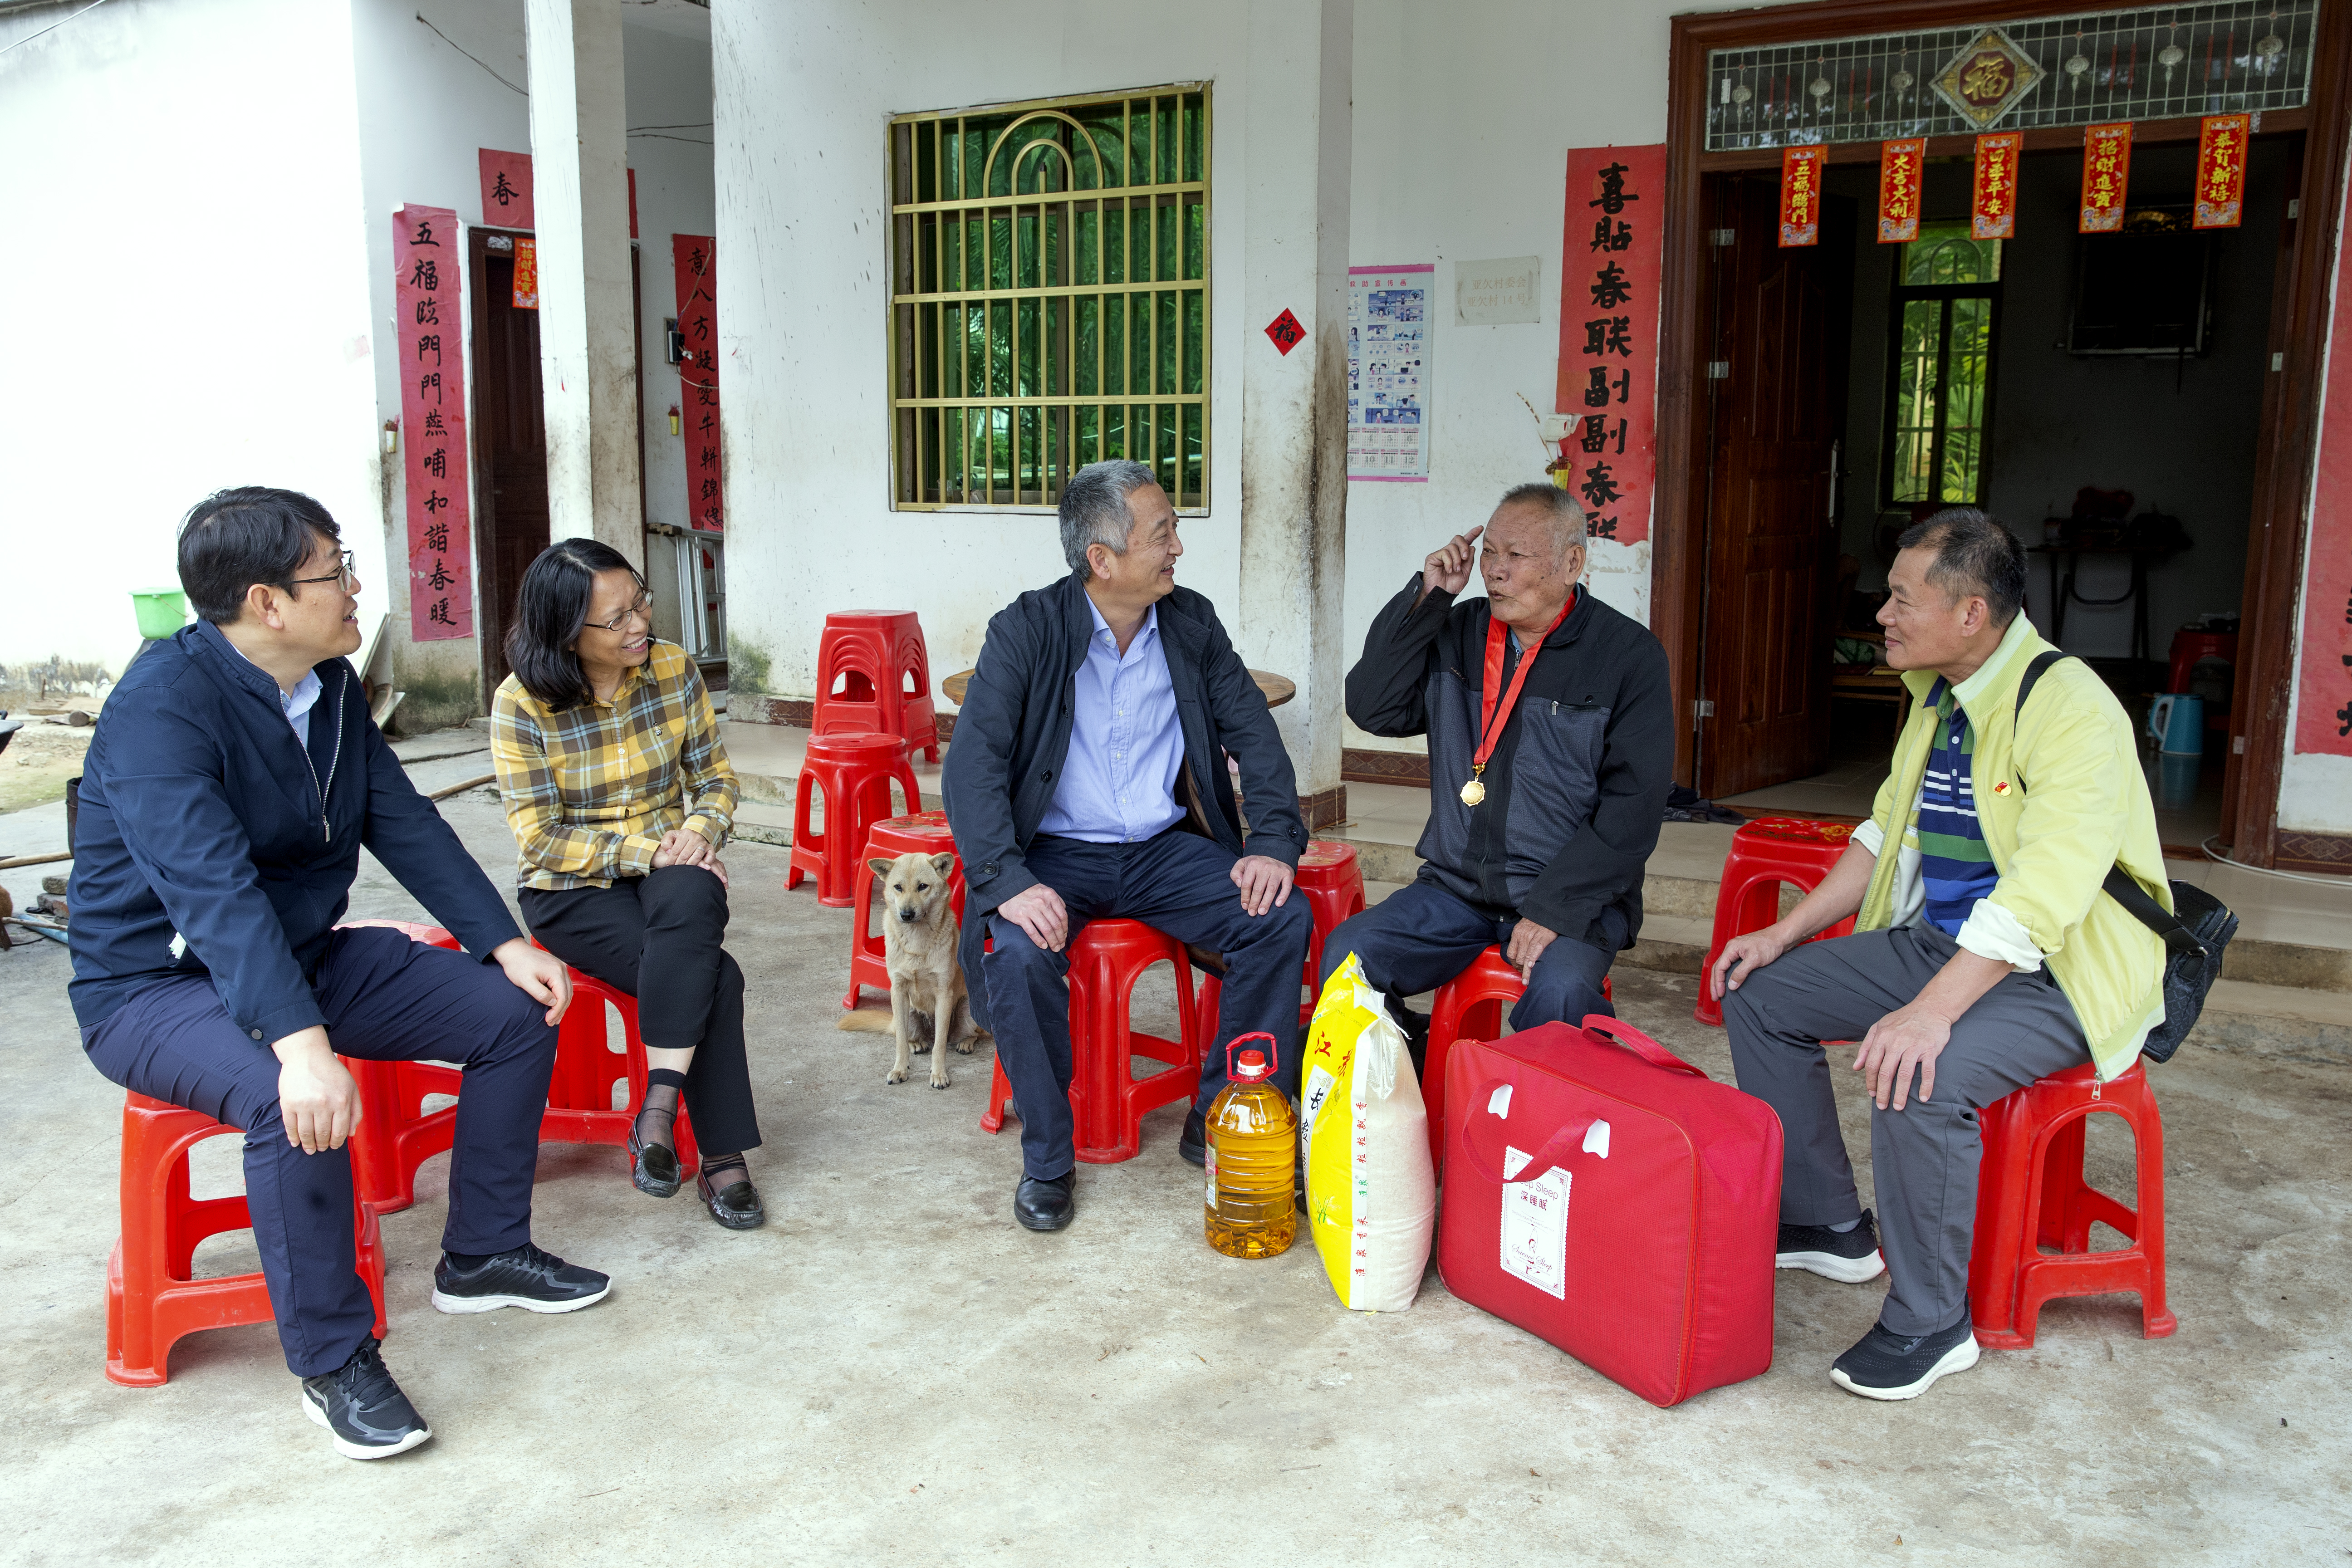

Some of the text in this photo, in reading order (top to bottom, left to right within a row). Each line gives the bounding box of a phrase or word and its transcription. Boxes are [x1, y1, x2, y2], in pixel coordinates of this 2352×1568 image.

[1962, 54, 2009, 101] 福
[491, 171, 519, 206] 春
[1889, 153, 1911, 218] 大吉大利
[1984, 148, 2006, 215] 四季平安
[1350, 279, 1406, 288] 救助宣传画
[1472, 276, 1526, 290] 亚欠村委会
[1468, 293, 1525, 307] 亚欠村 14 号
[1274, 317, 1296, 343] 福
[1315, 1030, 1353, 1078] 江苏
[1521, 1190, 1548, 1211] 深睡眠
[1535, 1182, 1558, 1201] Sleep
[1511, 1244, 1534, 1261] Science
[1535, 1256, 1552, 1272] Sleep
